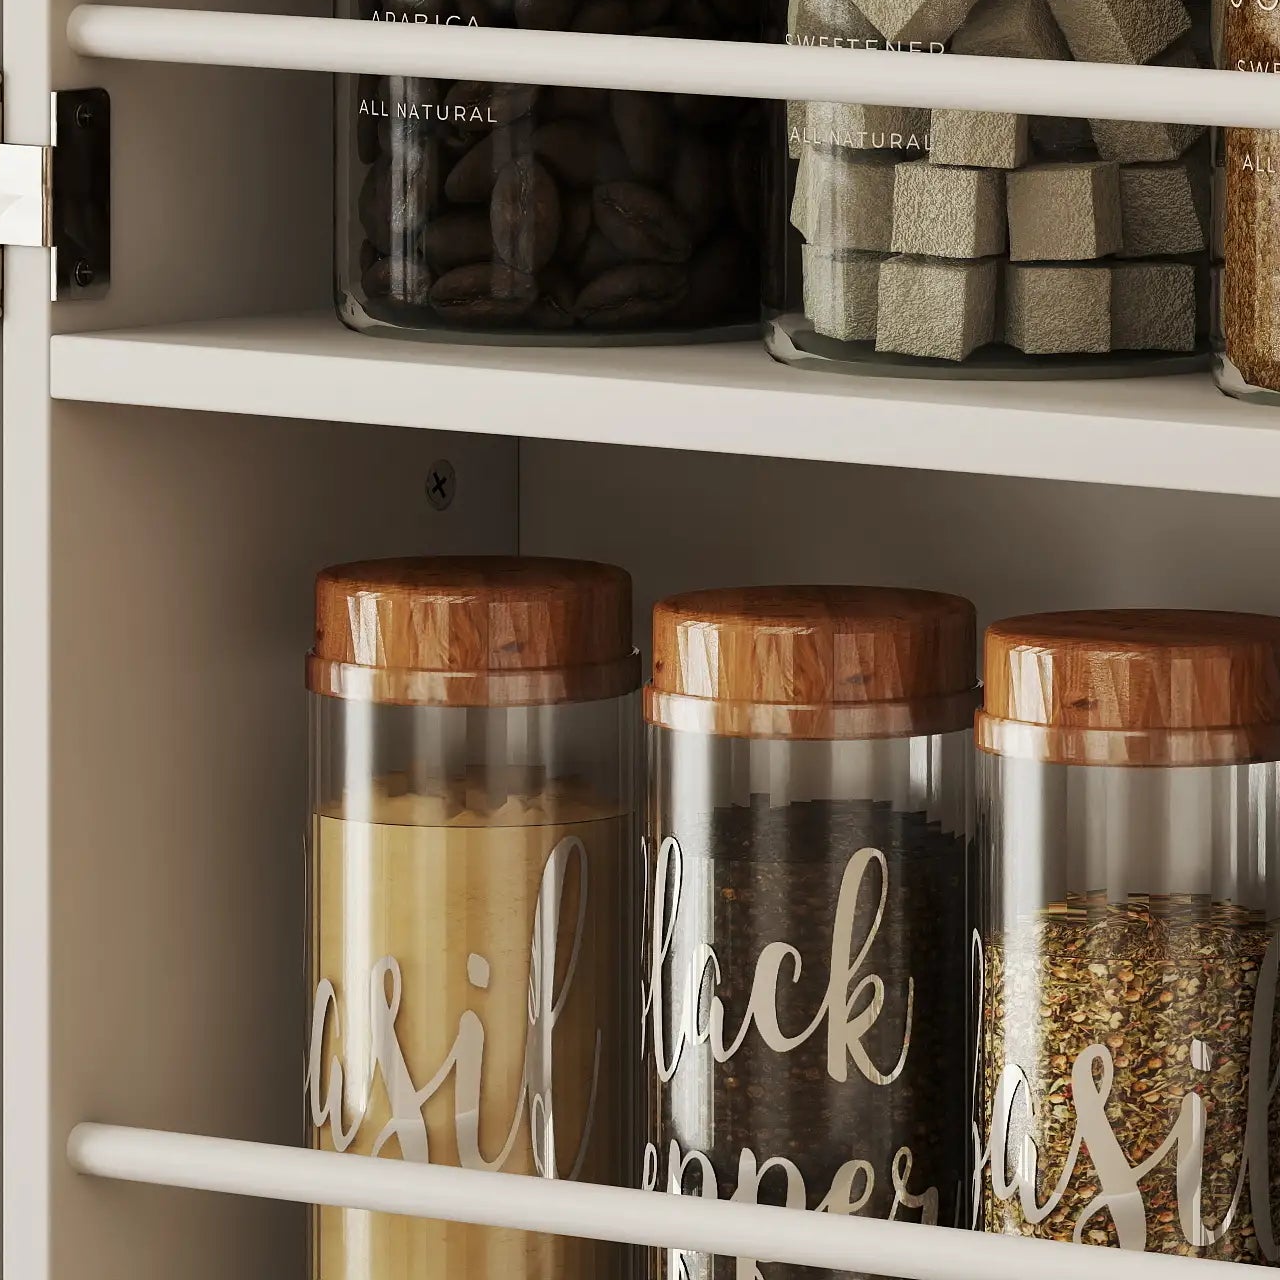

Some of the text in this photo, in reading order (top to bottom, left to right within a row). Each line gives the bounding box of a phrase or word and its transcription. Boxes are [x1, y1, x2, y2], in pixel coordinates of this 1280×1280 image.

[359, 99, 498, 123] ALL NATURAL
[790, 127, 932, 150] ALL NATURAL
[1242, 154, 1276, 173] ALL
